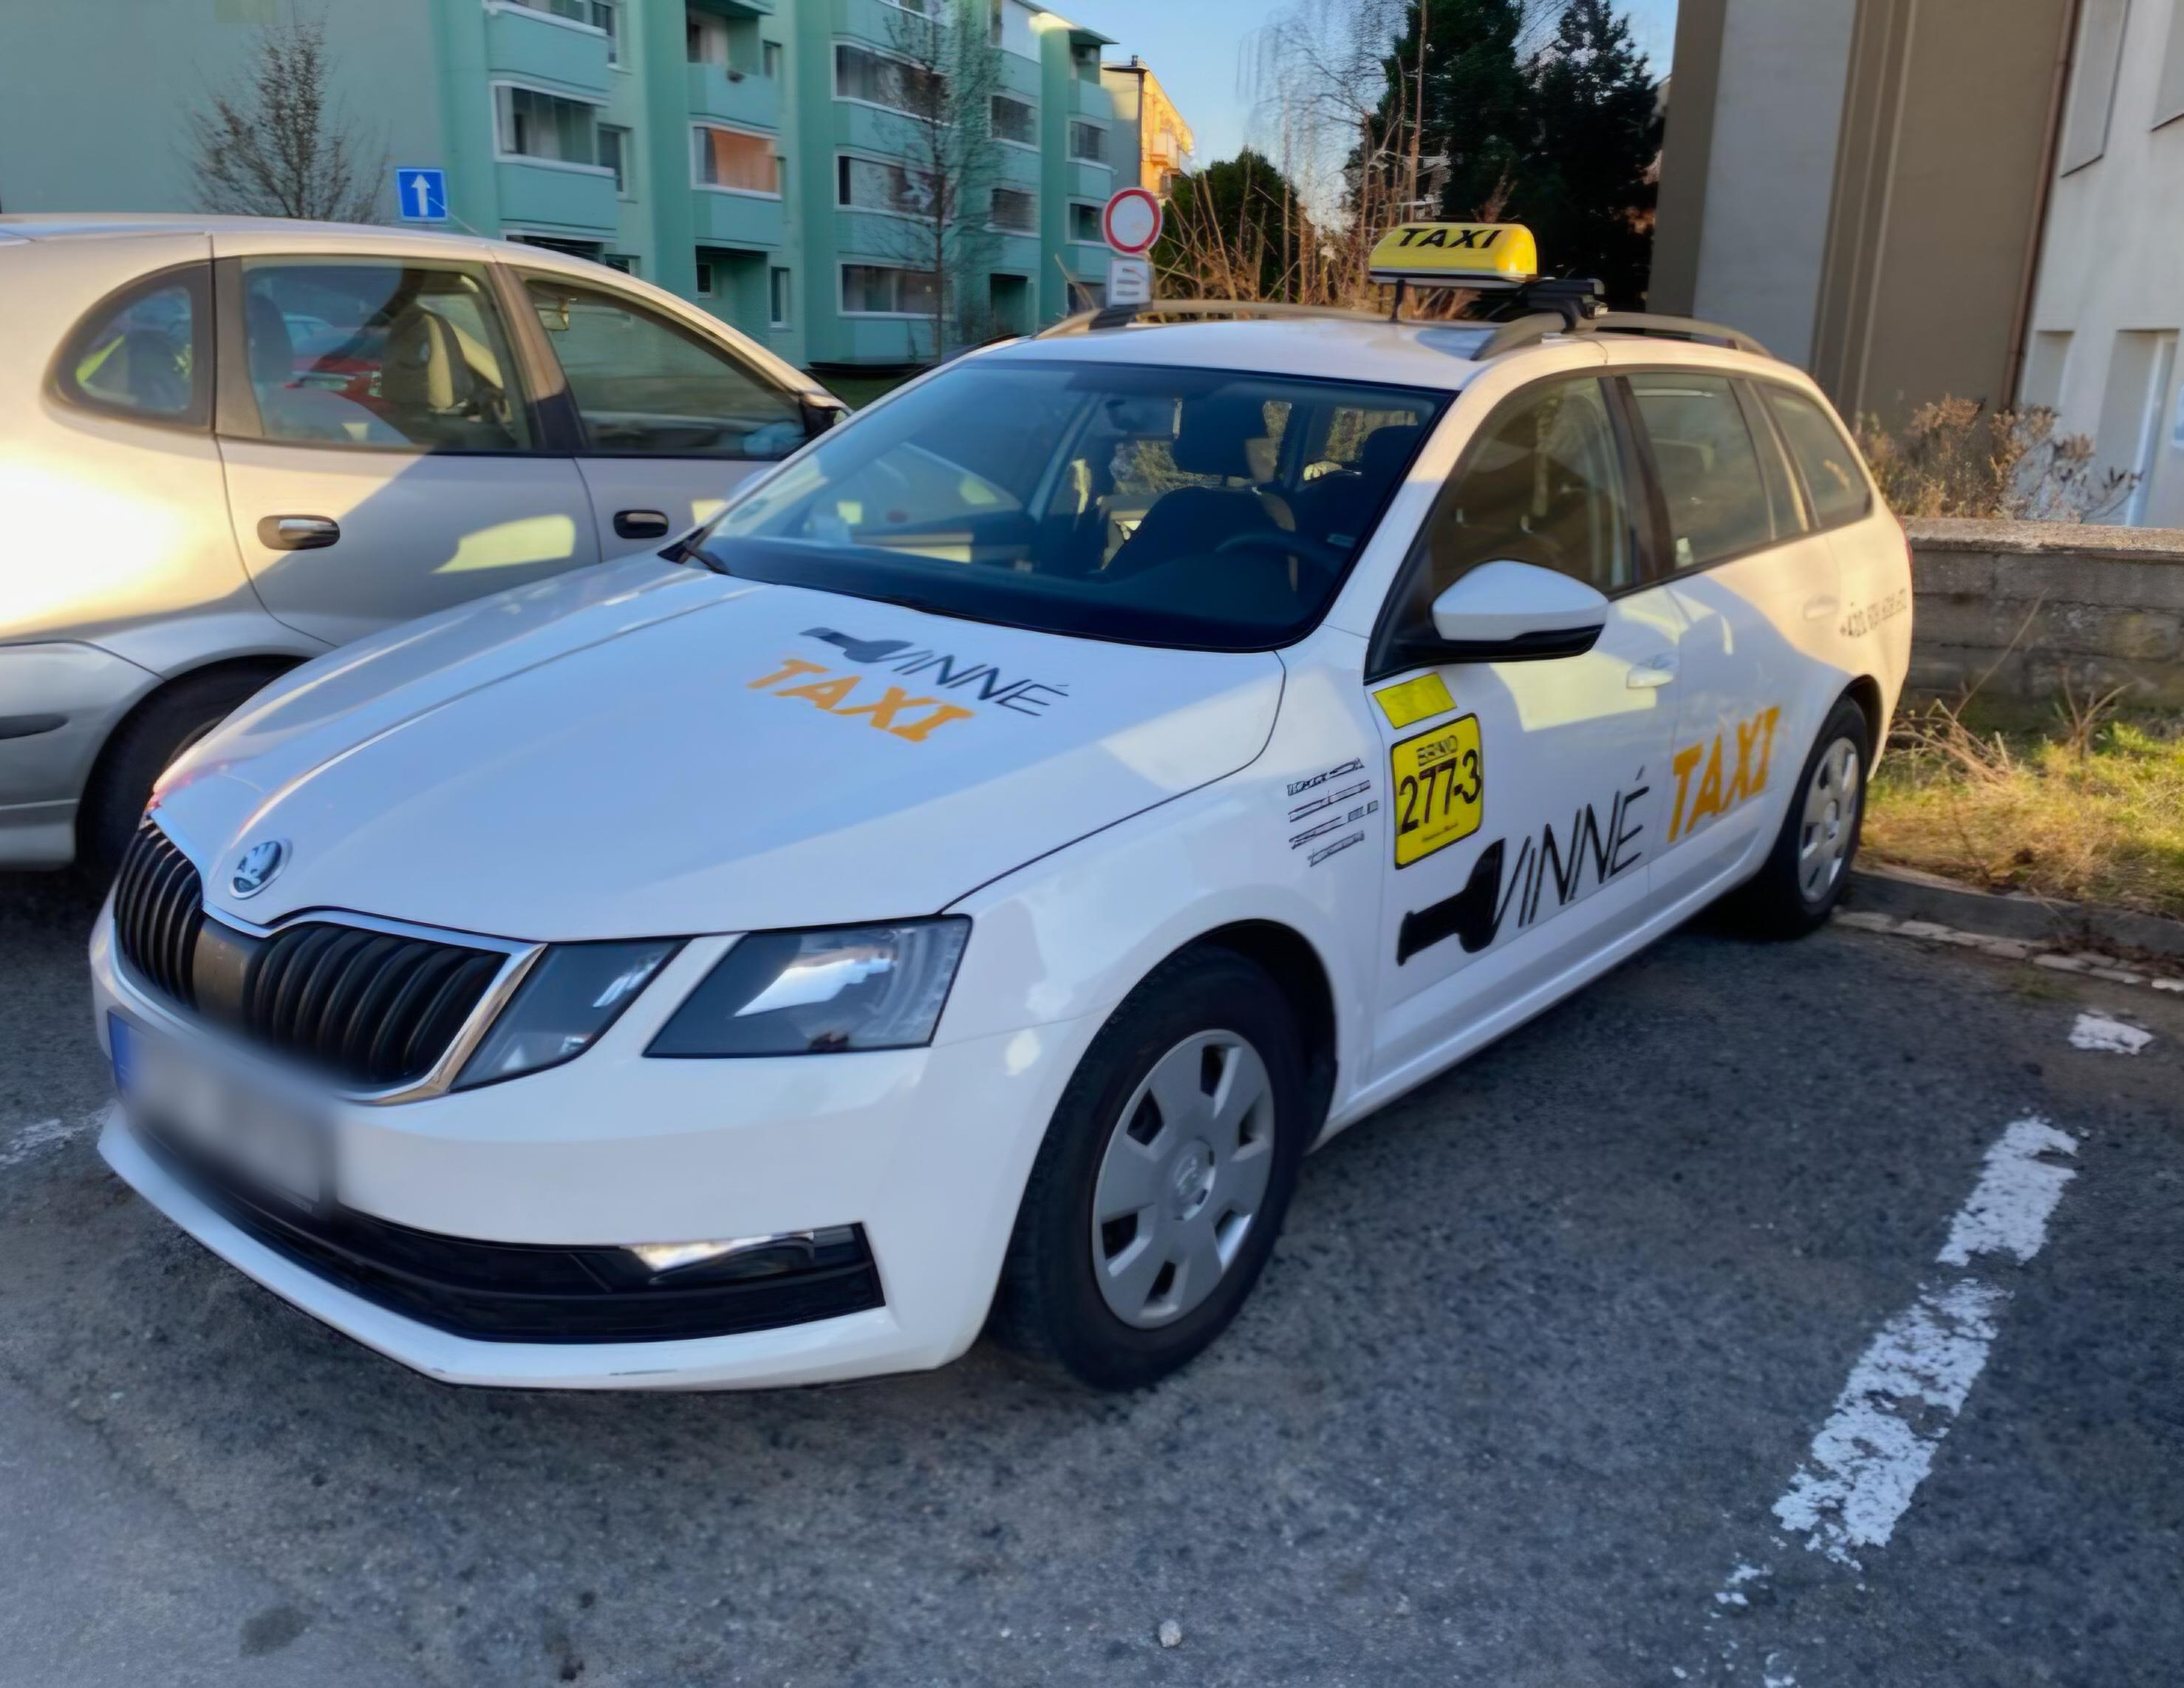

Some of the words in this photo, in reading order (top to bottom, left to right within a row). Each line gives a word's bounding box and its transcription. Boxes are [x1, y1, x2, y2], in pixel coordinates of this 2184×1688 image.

[1399, 228, 1504, 248] TAXI
[745, 658, 976, 743] TAXI
[1399, 749, 1481, 835] 277-3
[1667, 707, 1781, 844] TAXI
